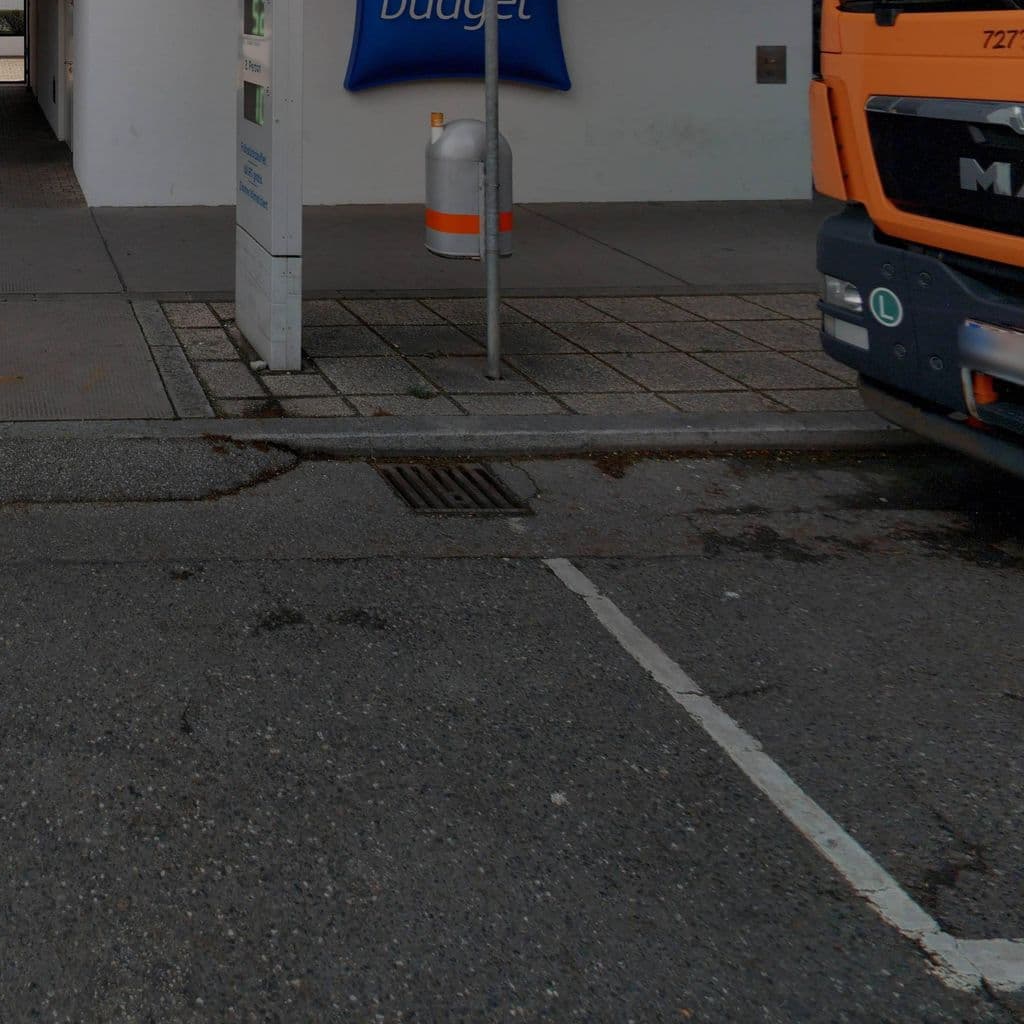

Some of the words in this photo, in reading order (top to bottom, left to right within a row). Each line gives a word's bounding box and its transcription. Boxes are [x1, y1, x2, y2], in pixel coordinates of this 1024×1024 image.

[983, 30, 1024, 49] 727
[960, 157, 1024, 198] M
[879, 295, 894, 320] L
